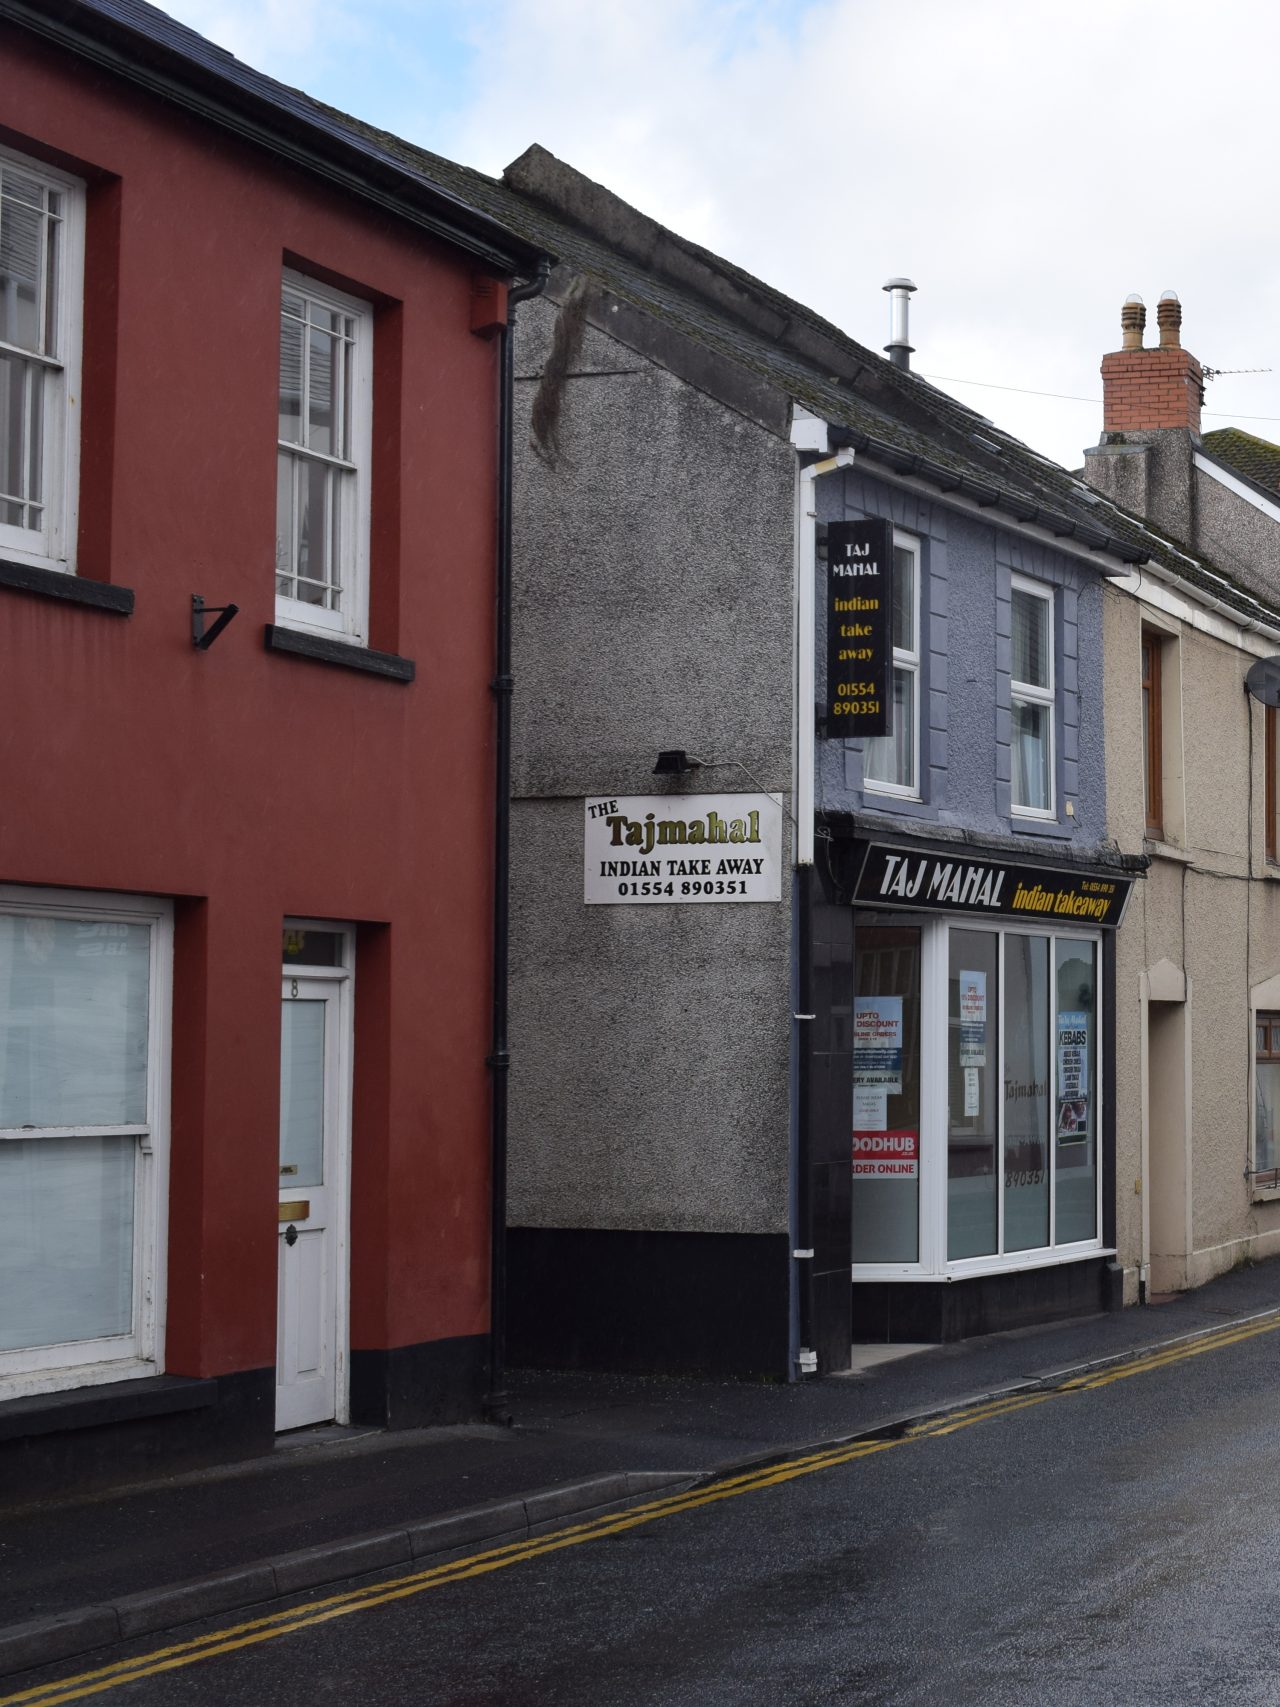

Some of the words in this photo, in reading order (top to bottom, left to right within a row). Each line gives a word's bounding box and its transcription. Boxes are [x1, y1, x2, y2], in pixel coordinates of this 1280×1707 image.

[845, 543, 870, 557] TAJ
[833, 562, 880, 577] MAHAL
[834, 596, 879, 612] indian
[840, 622, 873, 637] take
[838, 648, 873, 661] away
[837, 682, 875, 696] 01554
[833, 700, 880, 715] 890351
[588, 800, 619, 819] THE
[606, 810, 762, 855] Tajmahal
[600, 860, 661, 877] INDIAN
[667, 859, 711, 876] TAKE
[716, 858, 764, 875] AWAY
[618, 881, 674, 896] 01554
[681, 880, 747, 895] 890351
[879, 855, 927, 898] TAJ
[926, 862, 1005, 907] MAHAL
[1012, 880, 1053, 912] indian
[1053, 889, 1111, 921] takeaway
[291, 979, 299, 997] 8
[856, 1020, 899, 1028] DISCOUNT
[1060, 1031, 1086, 1045] KEBABS
[878, 1164, 914, 1173] ONLINE
